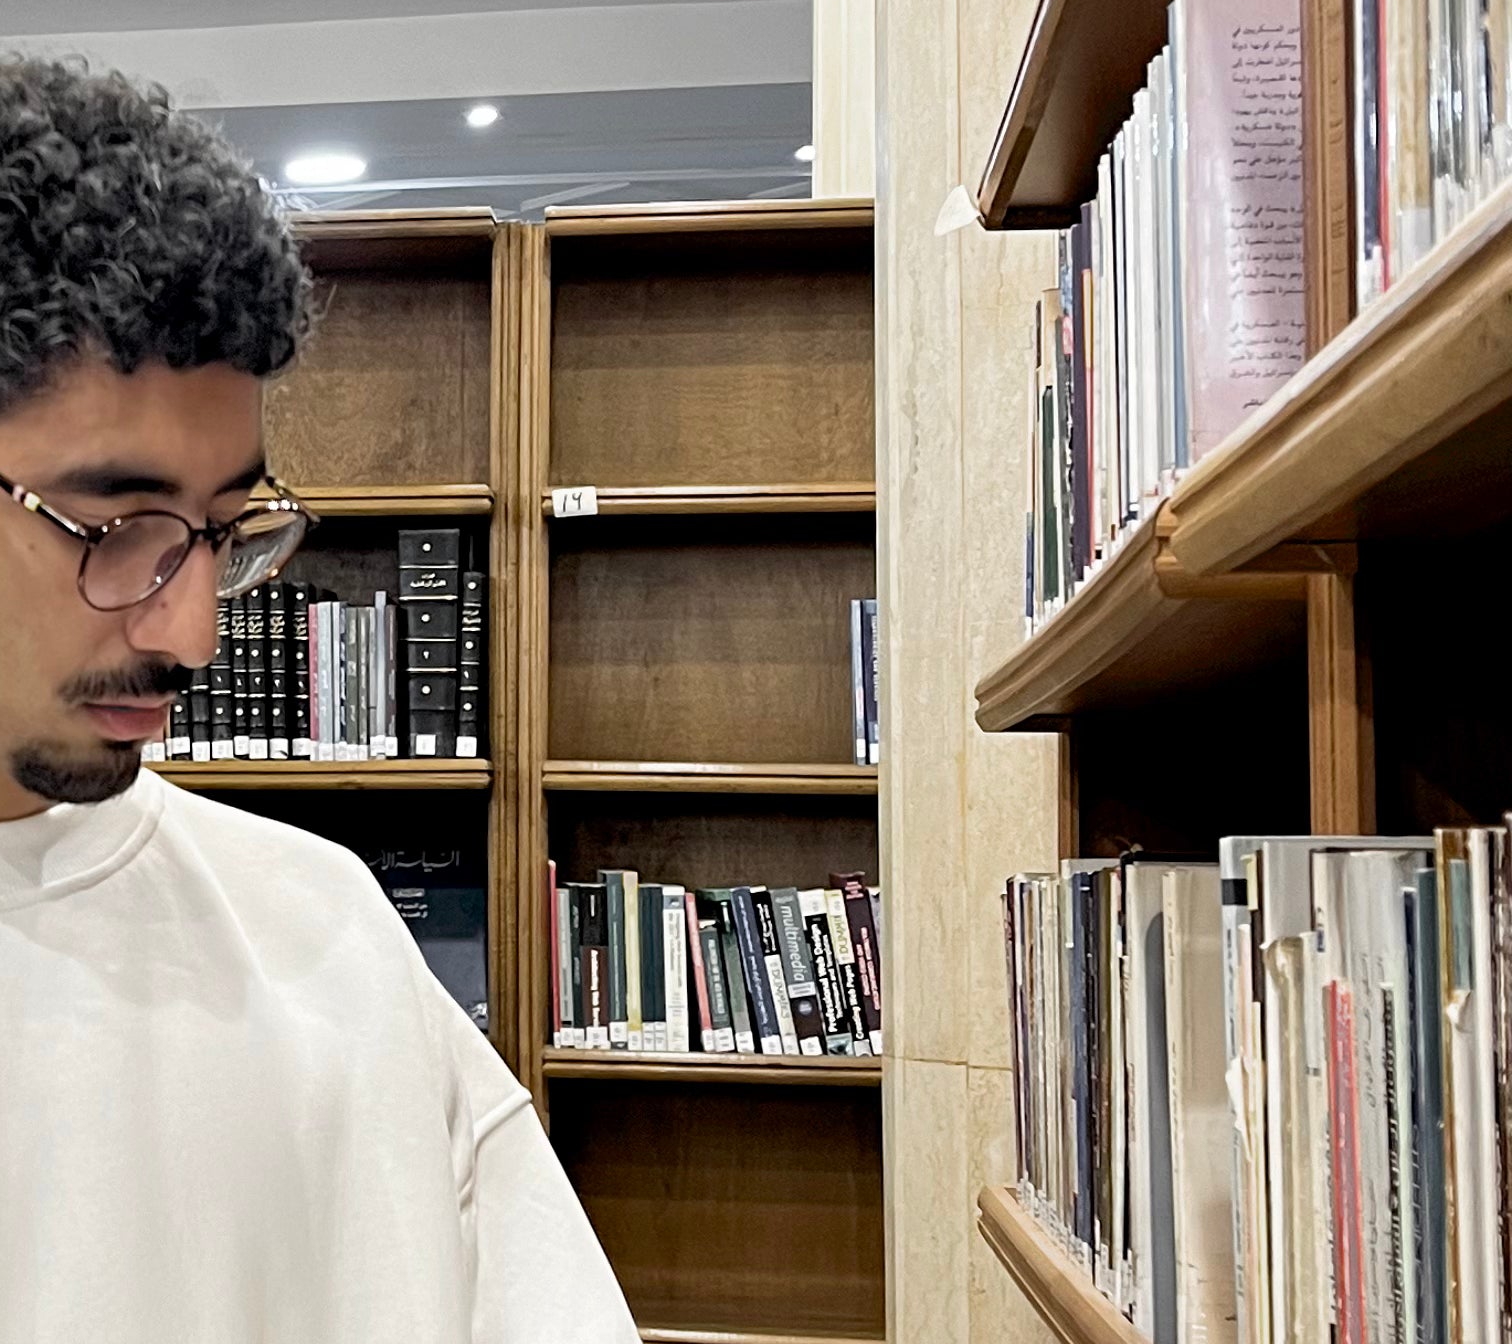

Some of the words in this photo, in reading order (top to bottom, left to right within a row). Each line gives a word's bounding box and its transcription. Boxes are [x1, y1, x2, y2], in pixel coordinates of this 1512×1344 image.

[780, 905, 806, 982] multimedia
[810, 923, 823, 956] Design
[816, 955, 827, 978] Web
[819, 977, 838, 1033] Professional
